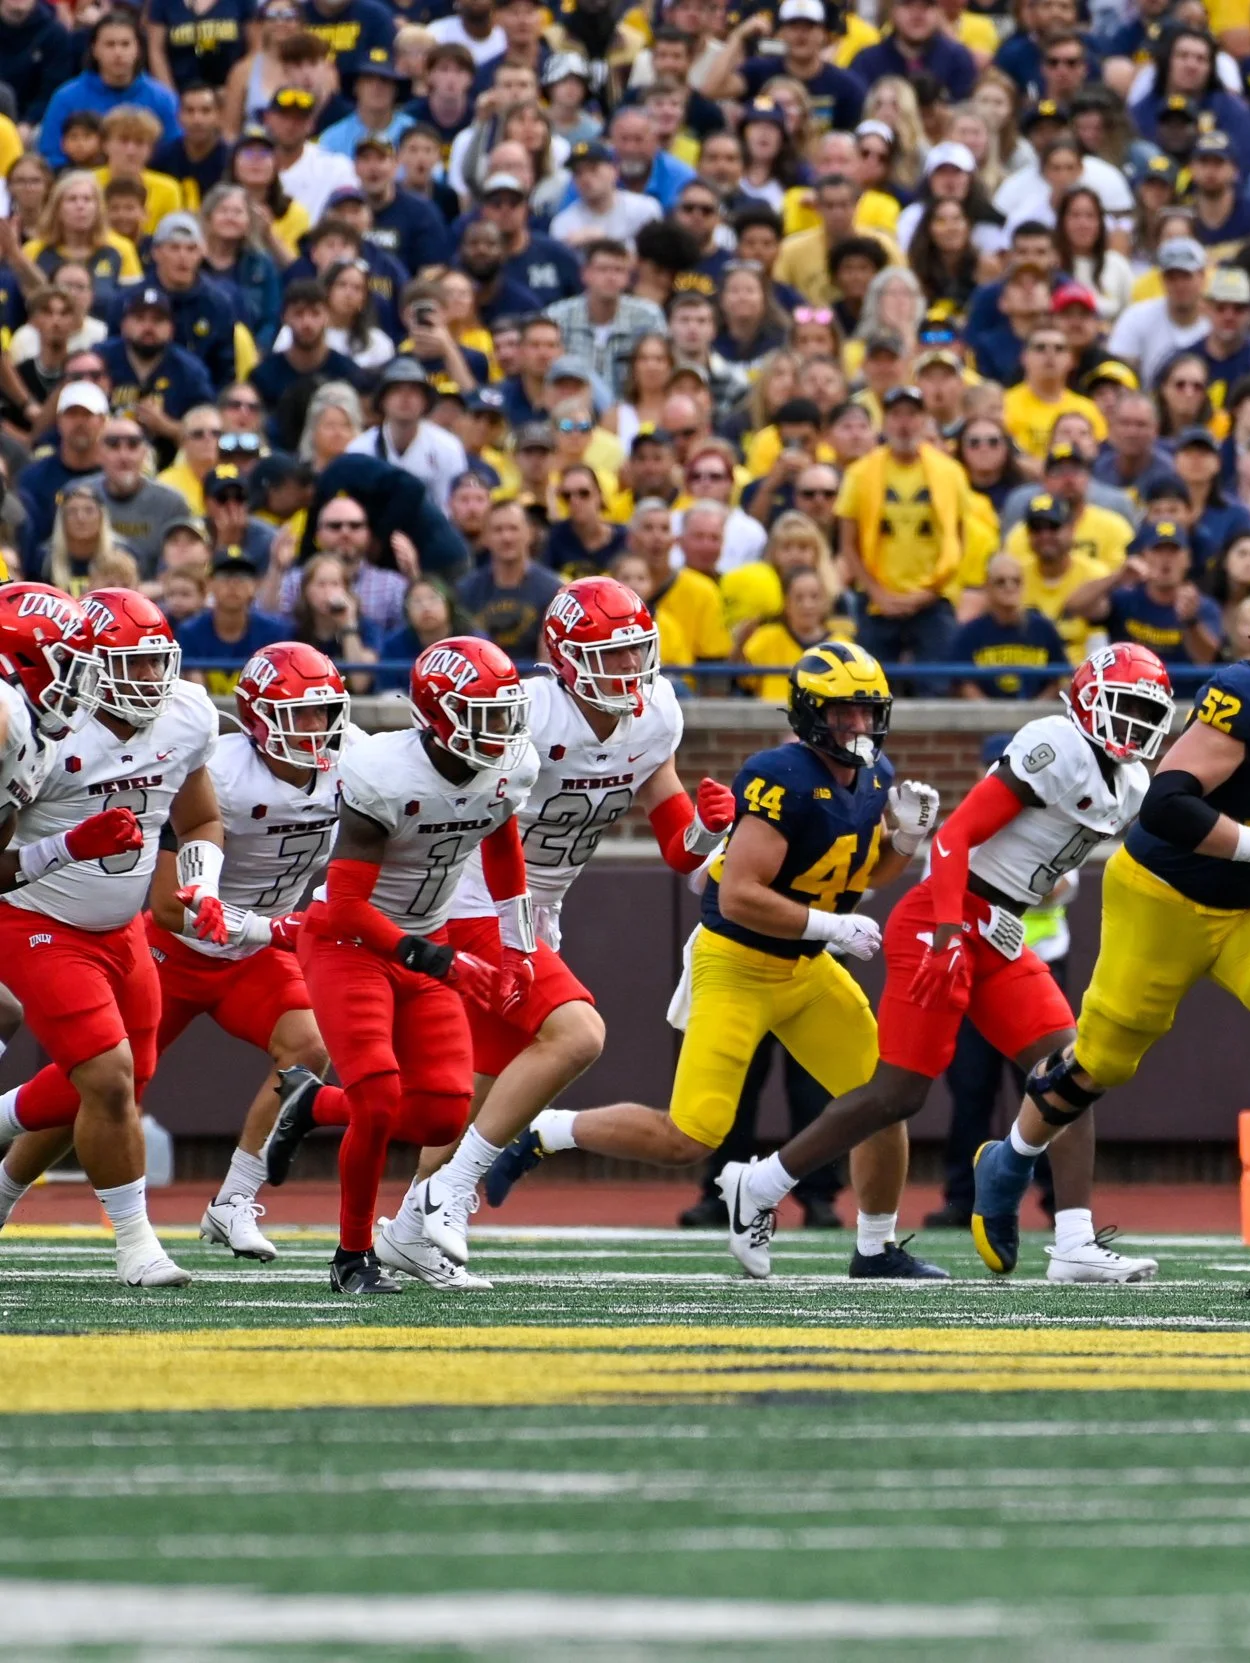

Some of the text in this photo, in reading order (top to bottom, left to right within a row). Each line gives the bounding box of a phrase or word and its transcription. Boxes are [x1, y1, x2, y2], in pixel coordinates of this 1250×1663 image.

[18, 593, 83, 640] UNLV
[79, 596, 115, 637] NLV
[545, 592, 585, 633] UNLV
[421, 649, 479, 692] UNLV
[1198, 687, 1242, 734] 52
[1023, 742, 1056, 774] 9
[88, 775, 163, 796] REBELS
[496, 777, 507, 798] C
[561, 773, 634, 790] REBELS
[744, 777, 785, 821] 44
[417, 817, 493, 834] REBELS
[253, 831, 325, 907] 7
[407, 836, 463, 917] 1
[29, 934, 52, 948] UNLV
